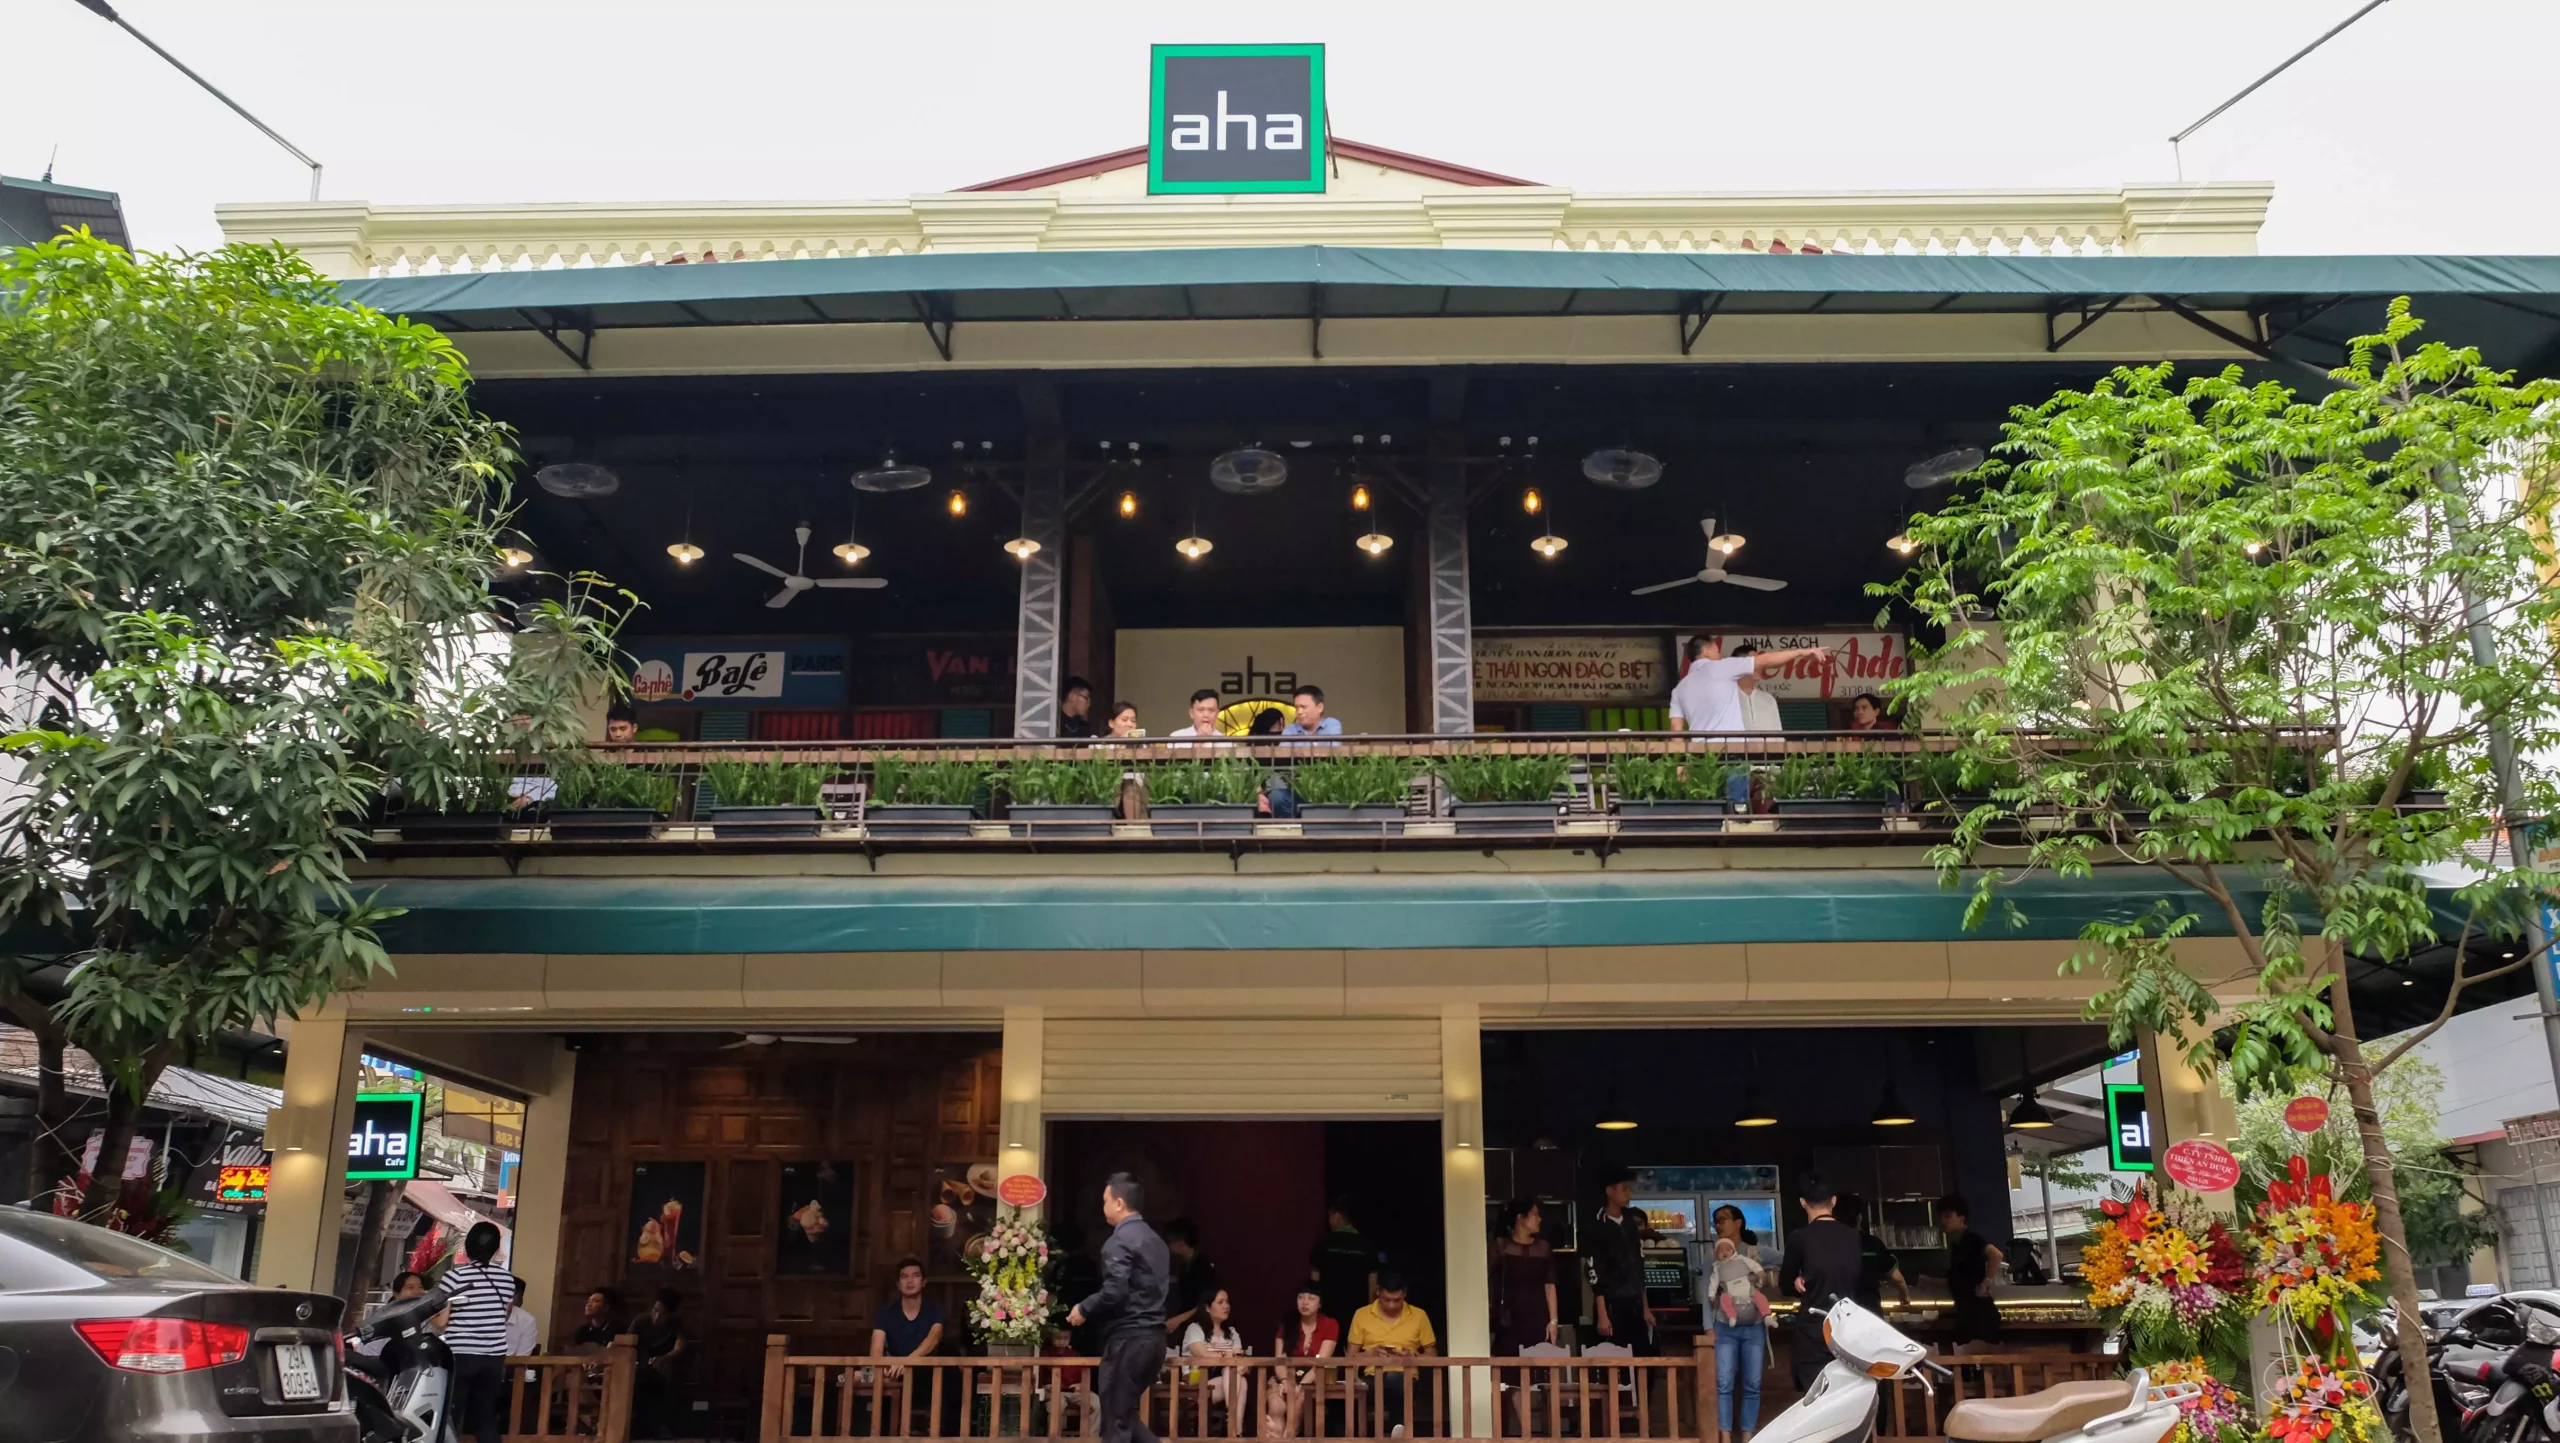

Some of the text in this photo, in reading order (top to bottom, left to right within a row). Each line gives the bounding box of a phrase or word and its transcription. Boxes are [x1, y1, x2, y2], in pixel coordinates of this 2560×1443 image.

[1171, 90, 1303, 151] aha
[1743, 634, 1819, 650] NHÀ SÁCH
[792, 655, 842, 671] PARIS
[1485, 660, 1520, 679] THÁI
[1524, 662, 1571, 679] NGON
[1620, 659, 1654, 680] BIỆT
[1221, 655, 1298, 695] aha
[348, 1119, 408, 1156] aha
[385, 1158, 406, 1167] Cafe
[2196, 1160, 2209, 1168] AN
[2204, 1152, 2228, 1164] TNHH
